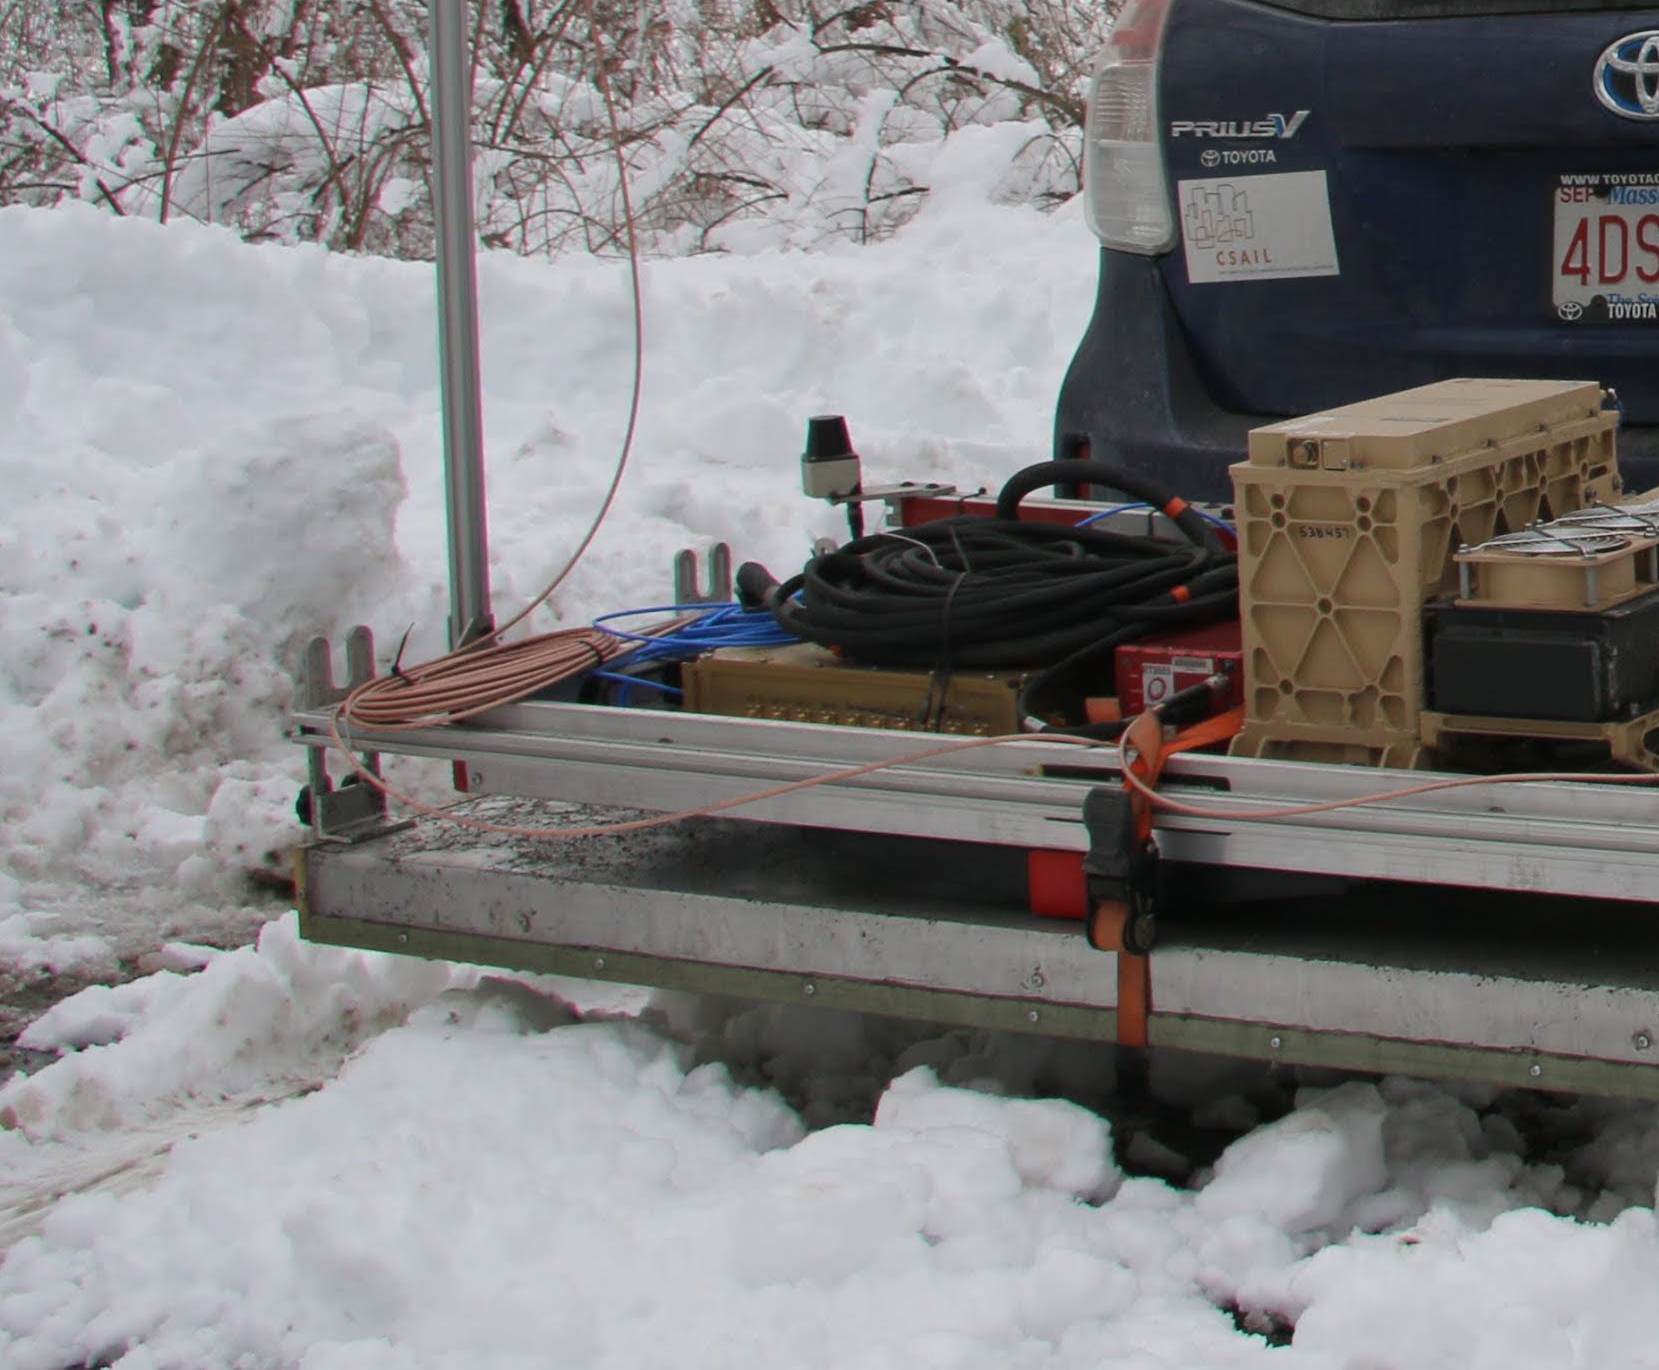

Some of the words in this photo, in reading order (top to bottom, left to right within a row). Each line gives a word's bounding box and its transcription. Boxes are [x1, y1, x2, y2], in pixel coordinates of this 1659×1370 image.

[1221, 149, 1277, 164] TOYOTA
[1216, 248, 1273, 266] CSAIL
[1607, 302, 1657, 319] TOYOTA
